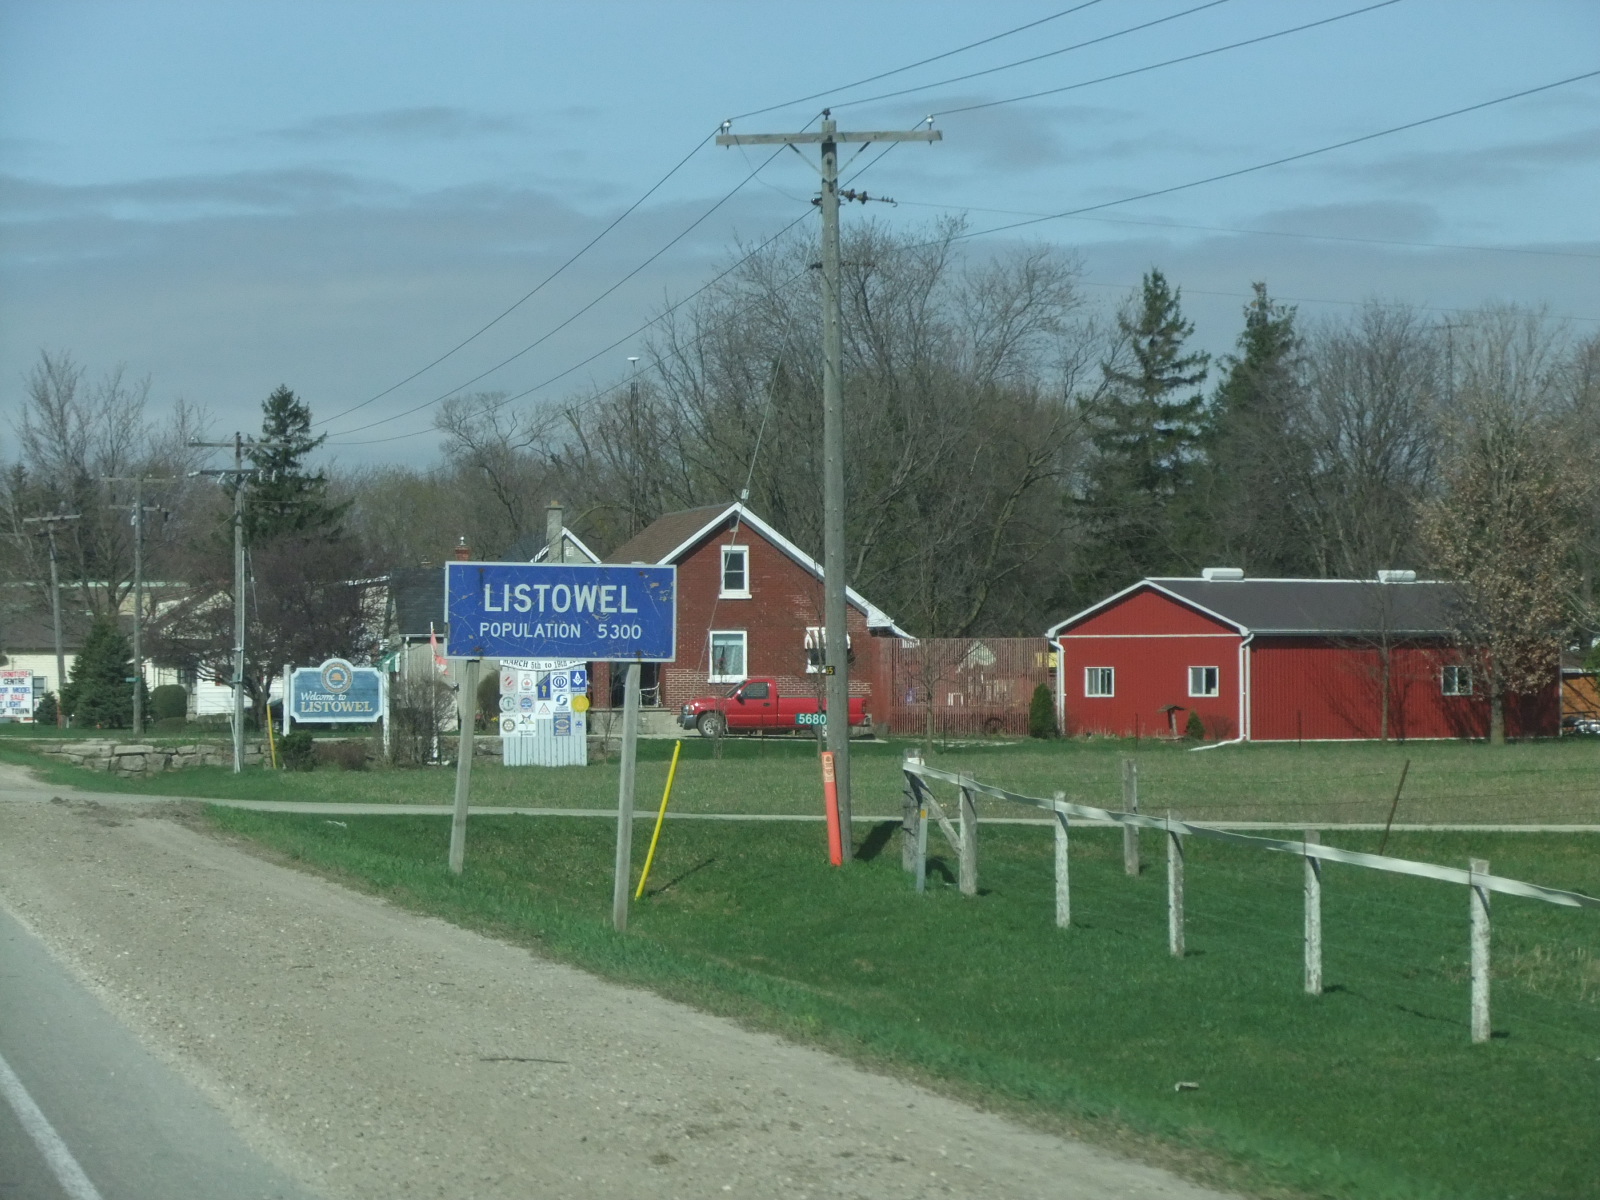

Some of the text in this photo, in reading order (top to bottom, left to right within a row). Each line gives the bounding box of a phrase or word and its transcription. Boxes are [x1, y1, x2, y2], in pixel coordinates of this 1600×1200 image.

[484, 584, 638, 613] LISTOWEL
[480, 622, 642, 640] POPULATION 5300
[301, 691, 346, 701] Welcome to
[301, 701, 373, 713] LISTOWEL
[798, 713, 827, 725] 5680
